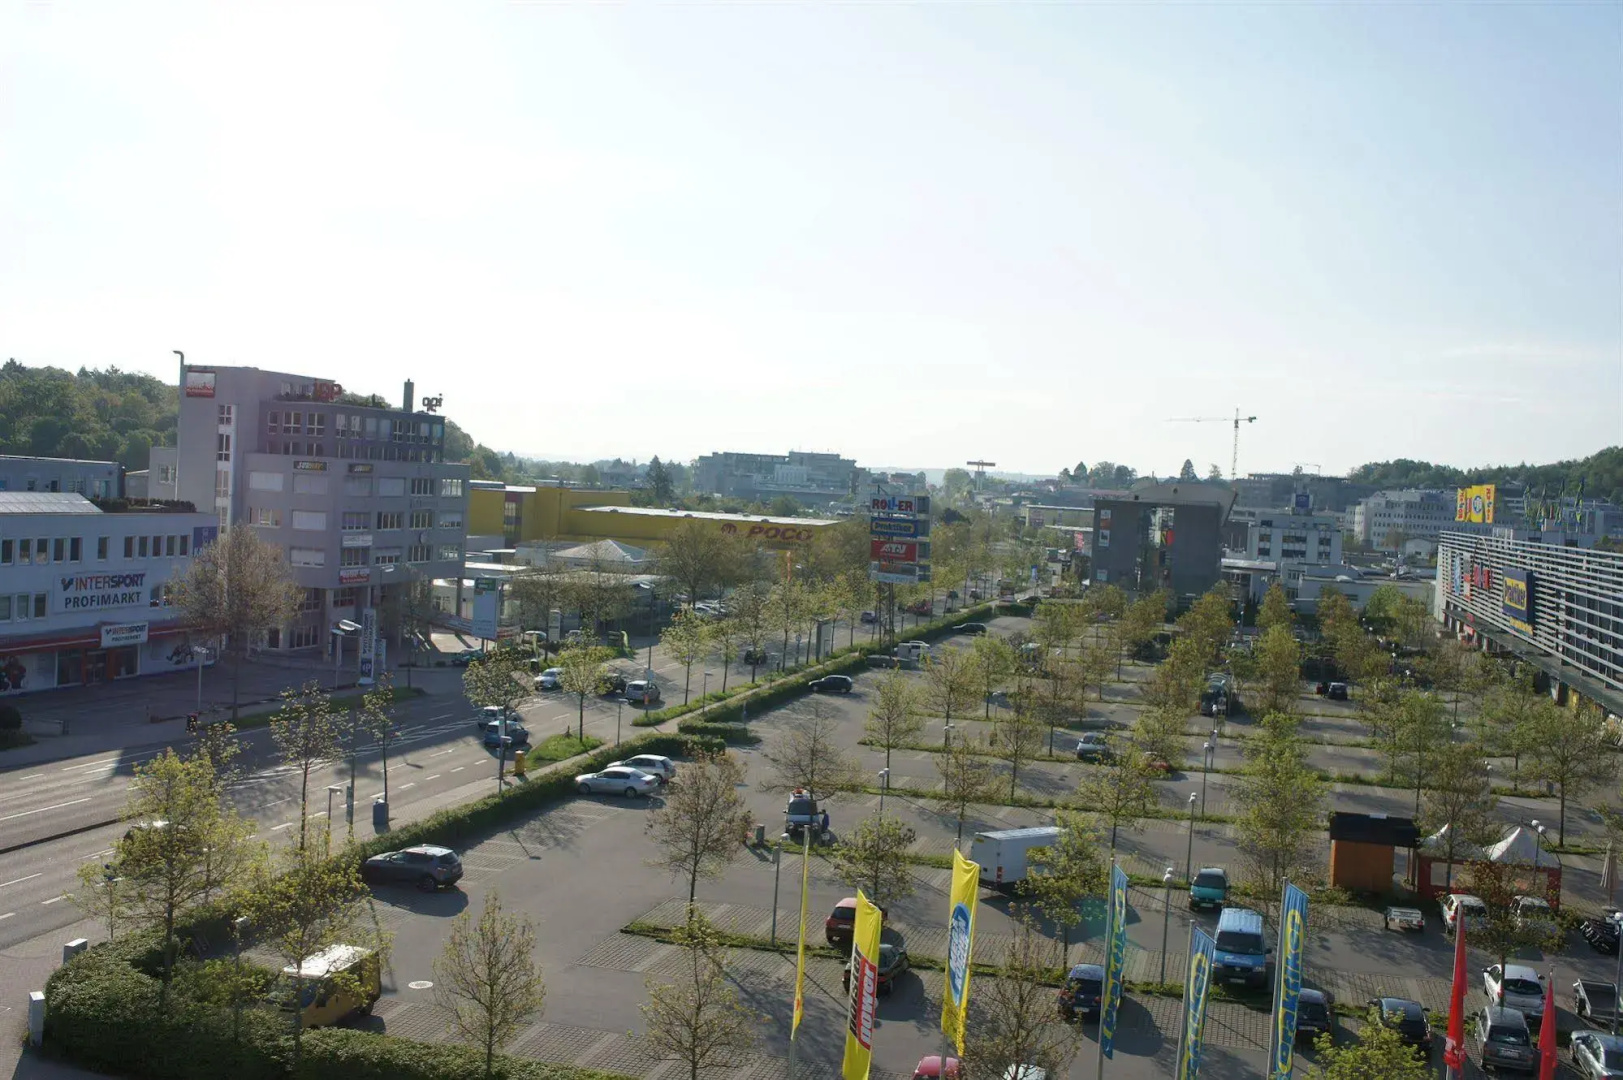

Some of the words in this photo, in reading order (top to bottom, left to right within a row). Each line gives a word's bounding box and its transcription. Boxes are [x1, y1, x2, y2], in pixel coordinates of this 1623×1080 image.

[745, 524, 814, 541] POCO
[74, 573, 146, 592] INTERSPORT
[64, 591, 142, 609] PROFIMARKT
